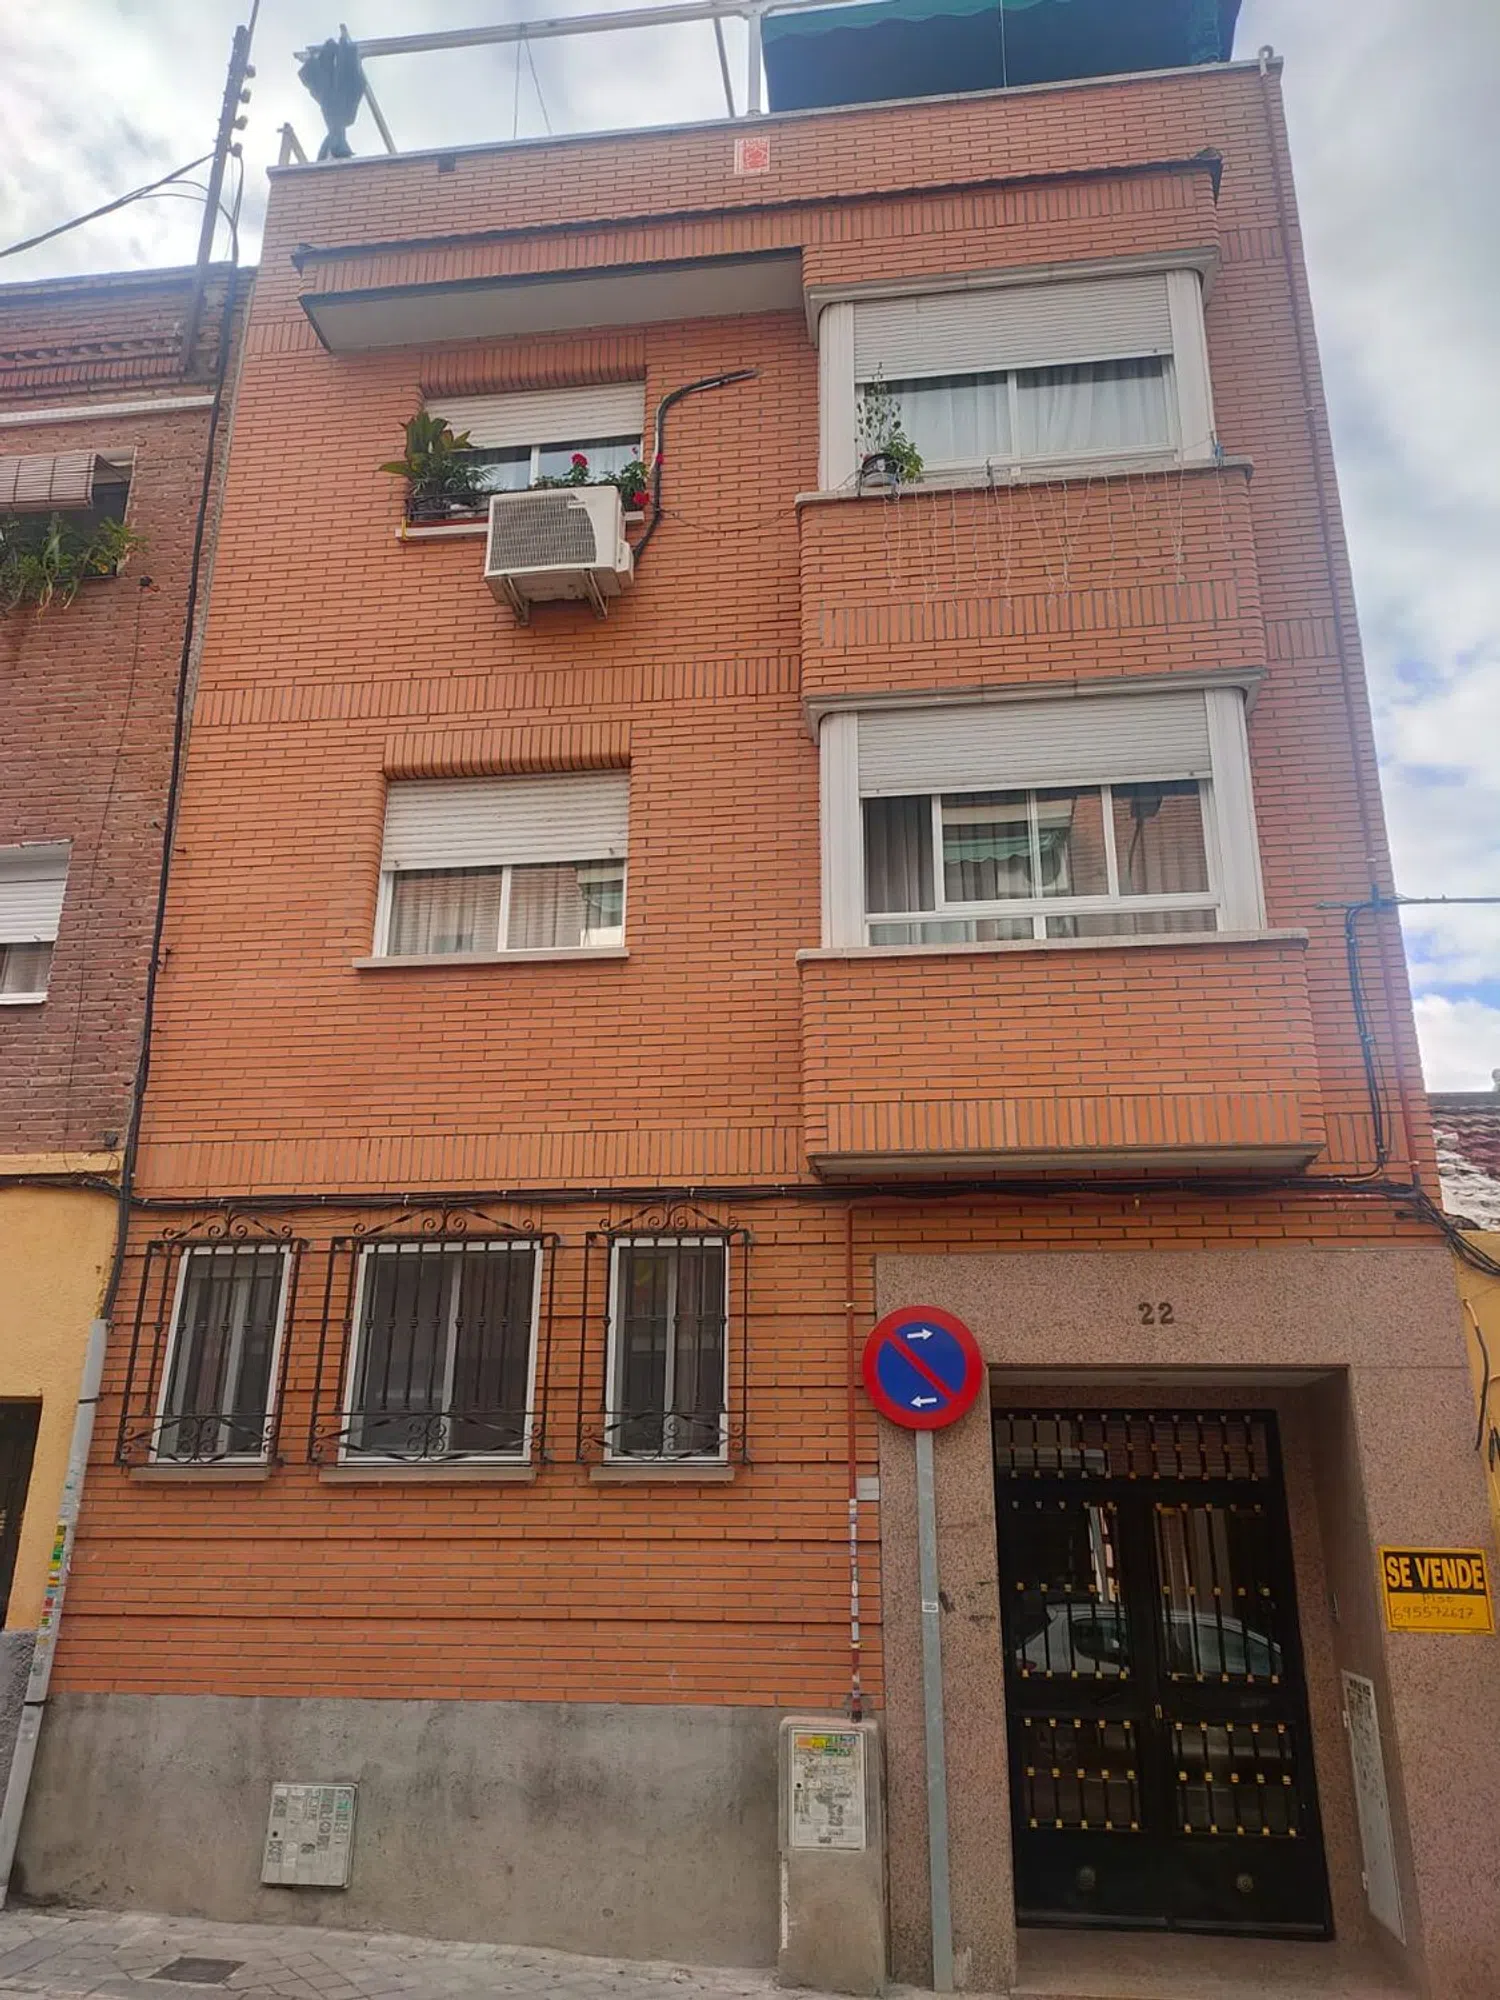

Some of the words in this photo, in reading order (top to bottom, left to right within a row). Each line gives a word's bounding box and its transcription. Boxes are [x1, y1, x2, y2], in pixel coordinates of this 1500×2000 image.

[1138, 1302, 1174, 1325] 22
[1386, 1556, 1413, 1588] SE
[1414, 1557, 1485, 1590] VENDE
